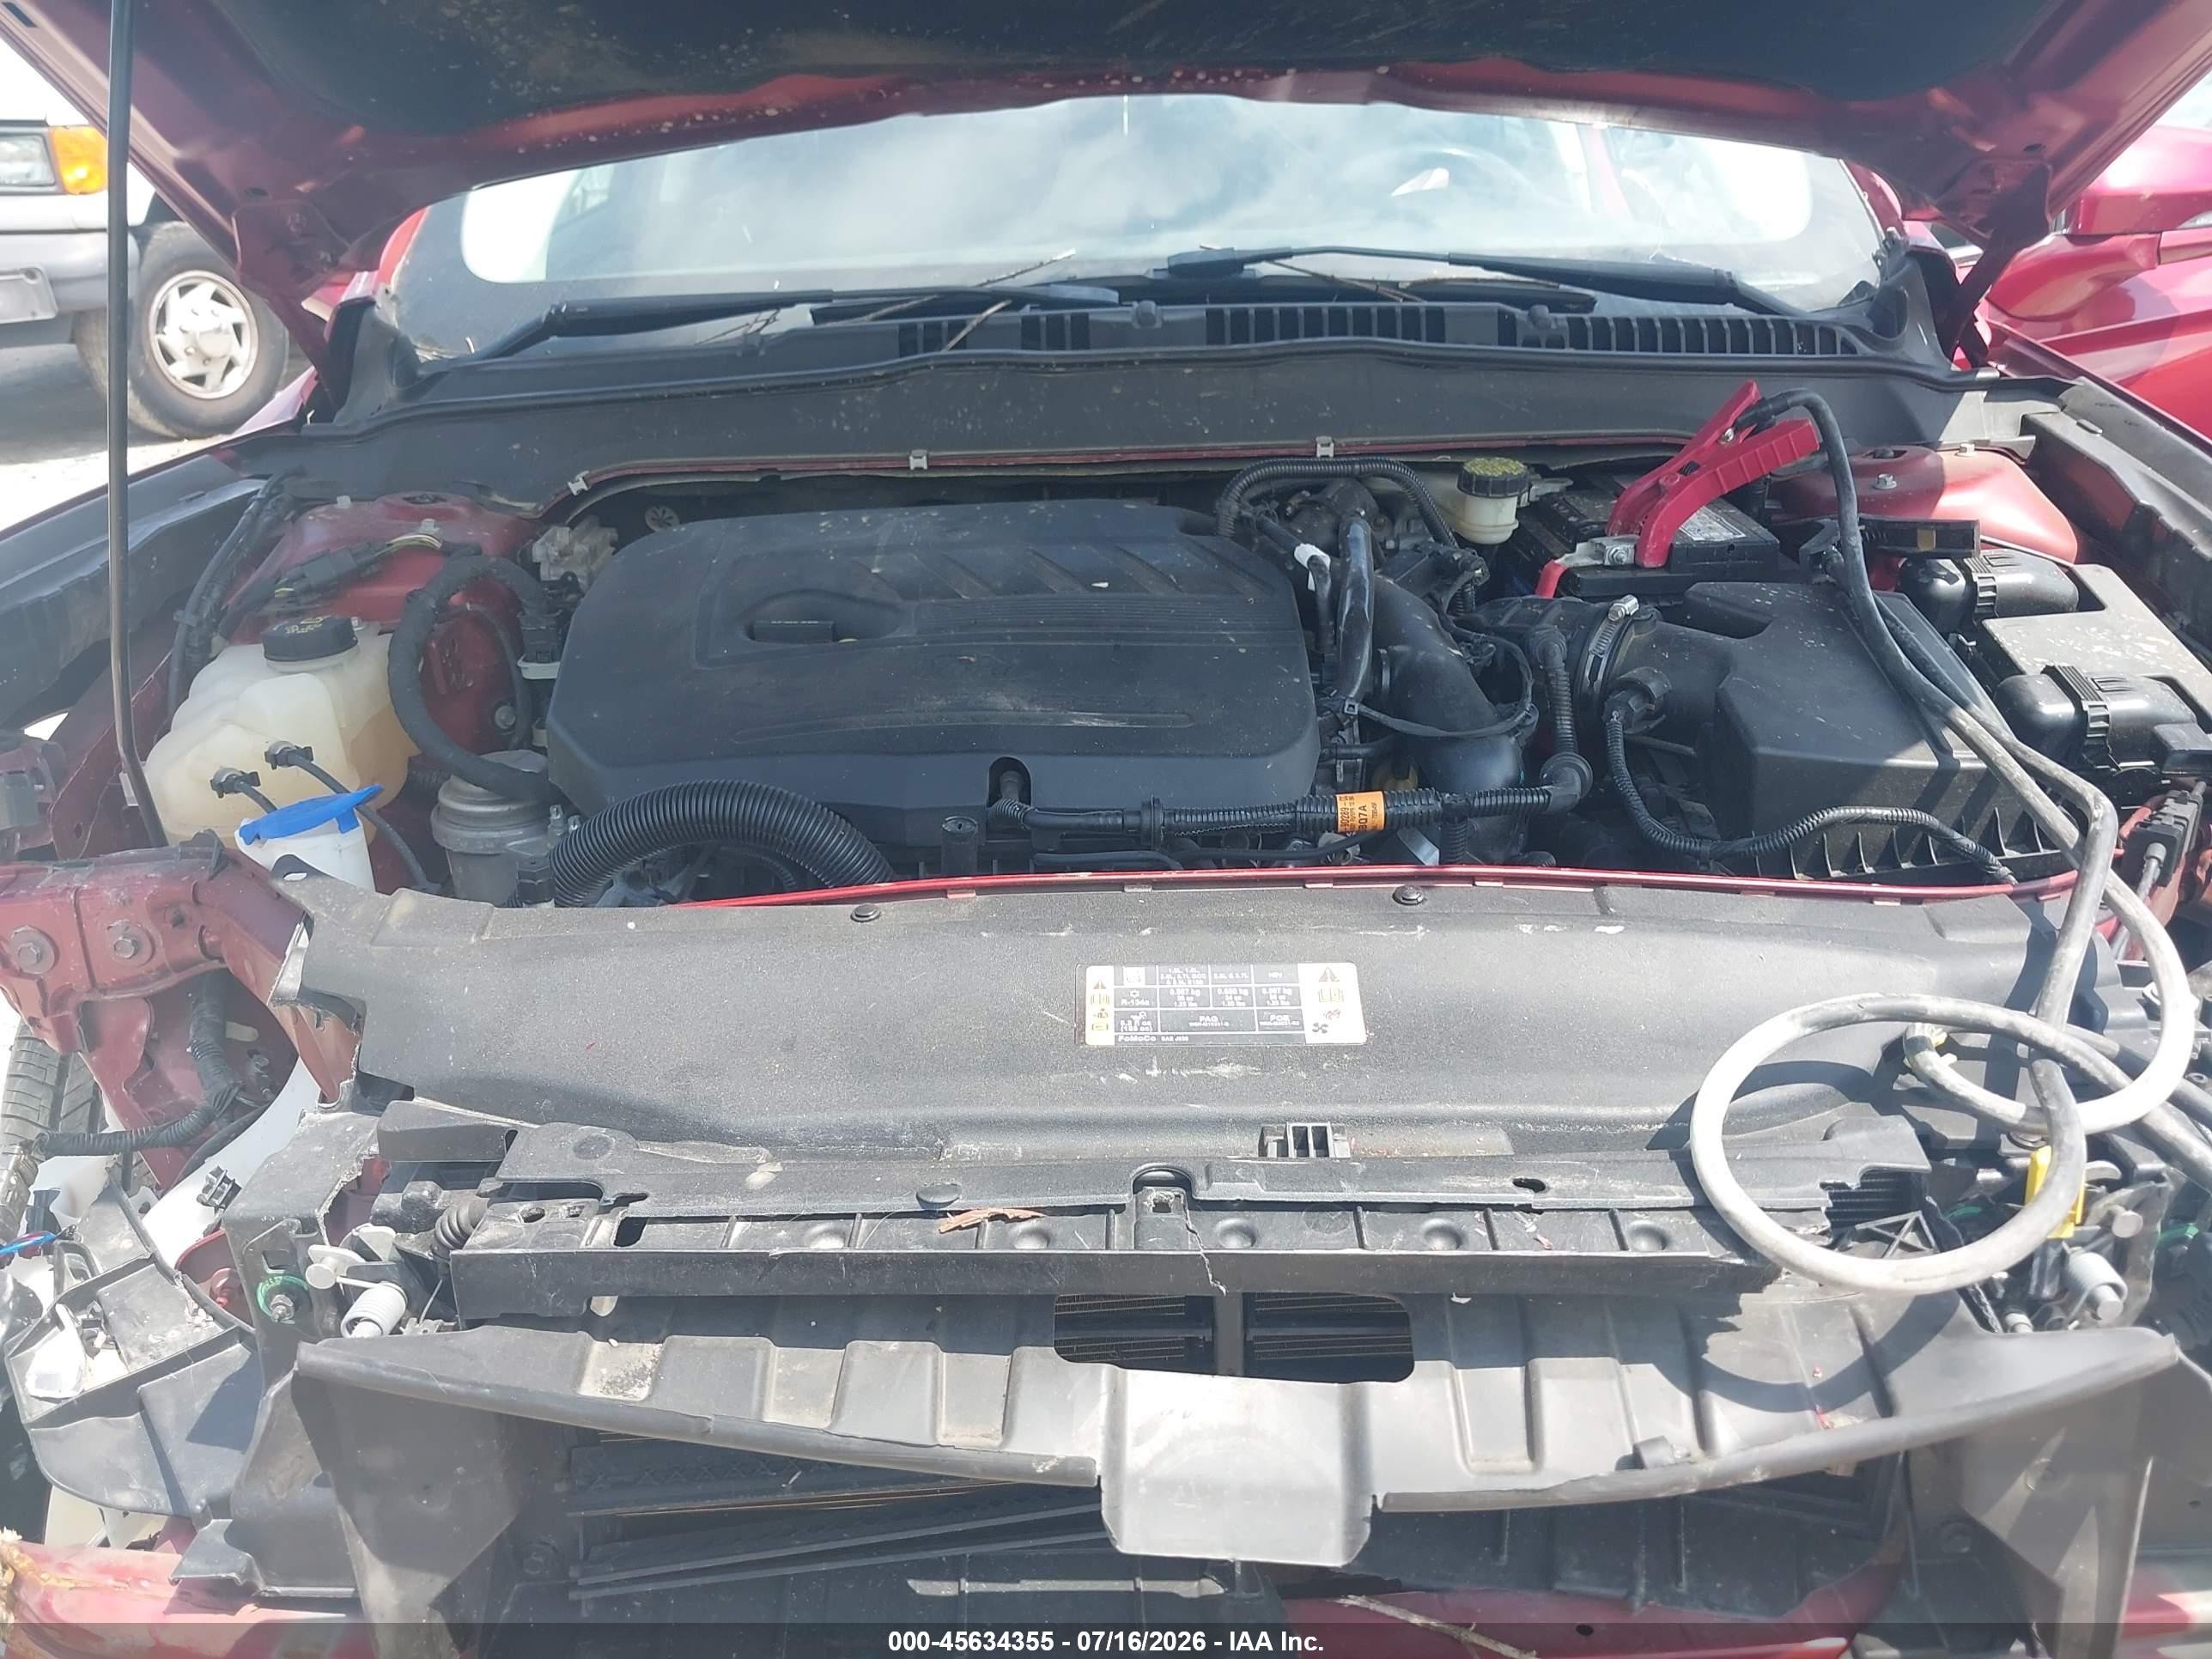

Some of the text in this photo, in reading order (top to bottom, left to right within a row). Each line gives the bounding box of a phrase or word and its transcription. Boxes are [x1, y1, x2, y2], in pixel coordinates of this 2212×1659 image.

[1190, 988, 1200, 997] kg
[1238, 988, 1249, 996] kg
[1282, 987, 1292, 995] kg
[1121, 998, 1151, 1006] R-134a
